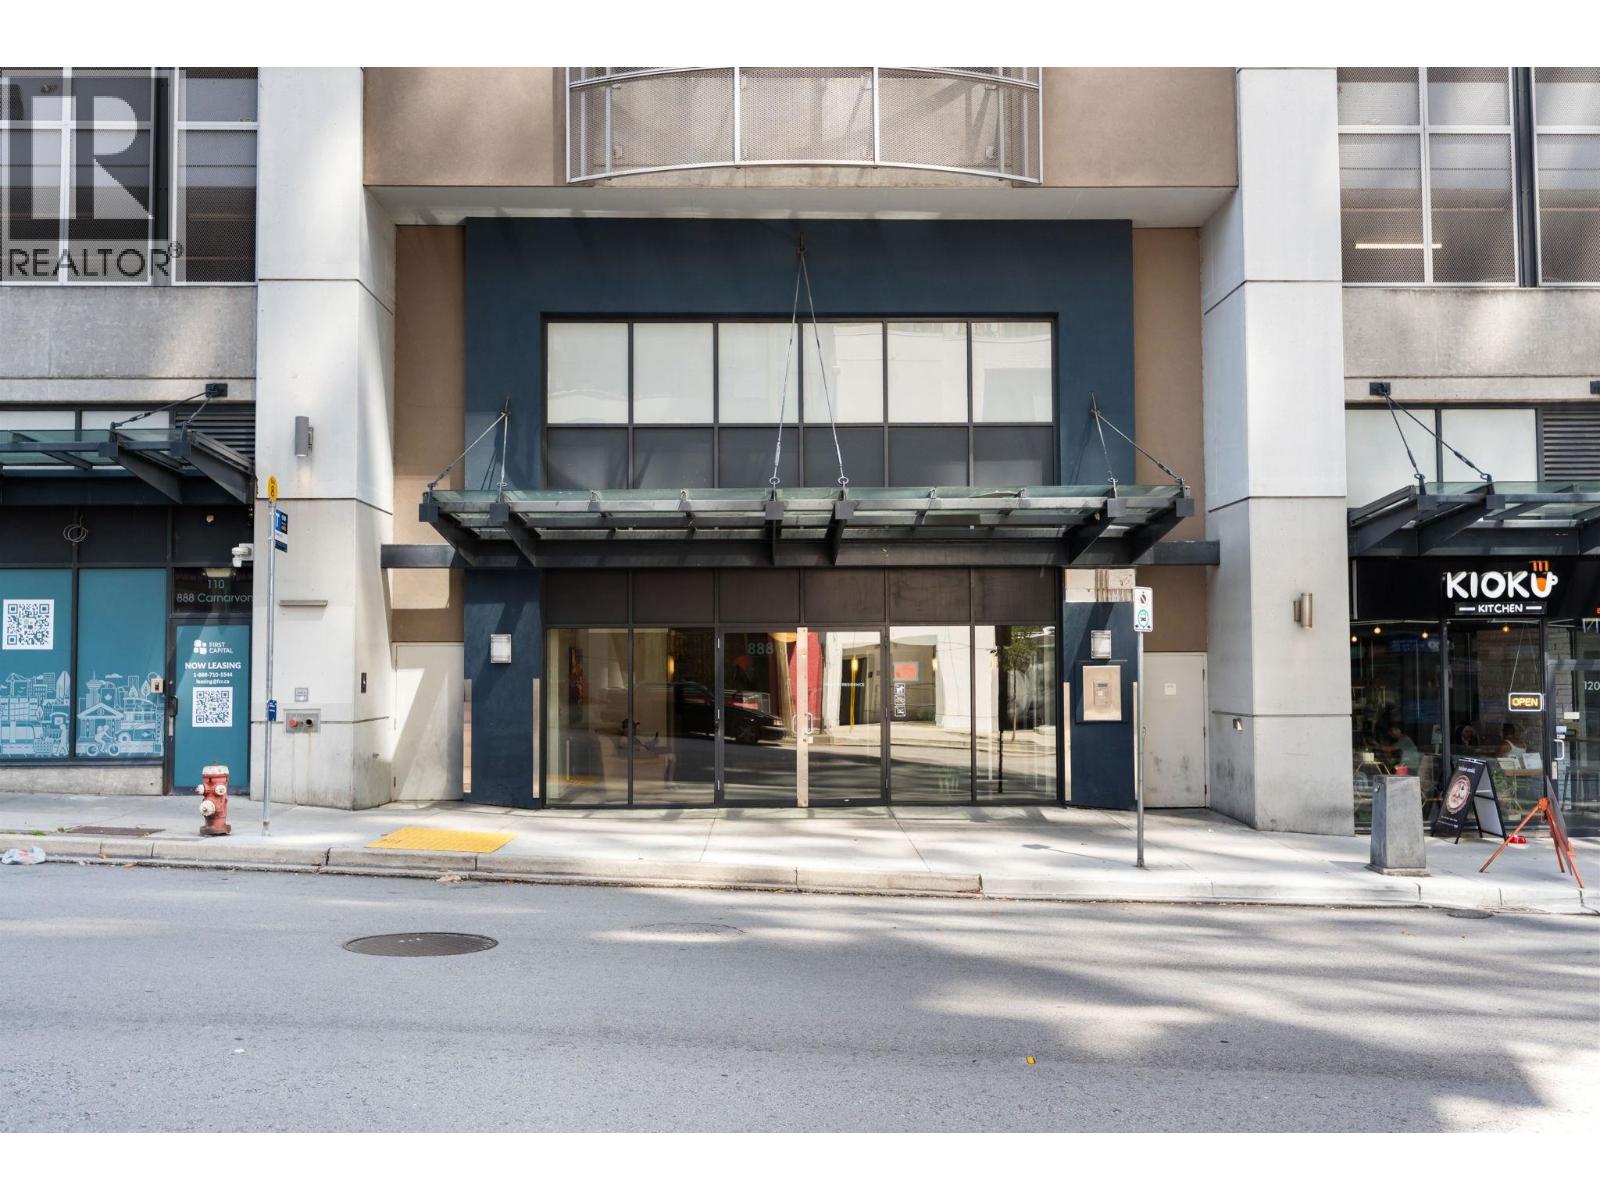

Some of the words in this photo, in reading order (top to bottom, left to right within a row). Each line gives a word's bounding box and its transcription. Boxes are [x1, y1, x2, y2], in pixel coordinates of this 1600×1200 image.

[207, 579, 225, 589] 110
[1446, 571, 1559, 599] KIOKU
[177, 593, 195, 603] 888
[1478, 604, 1523, 613] KITCHEN
[748, 642, 774, 655] 888
[184, 662, 206, 670] NOW
[207, 662, 242, 670] LEASING
[1511, 697, 1539, 707] OPEN
